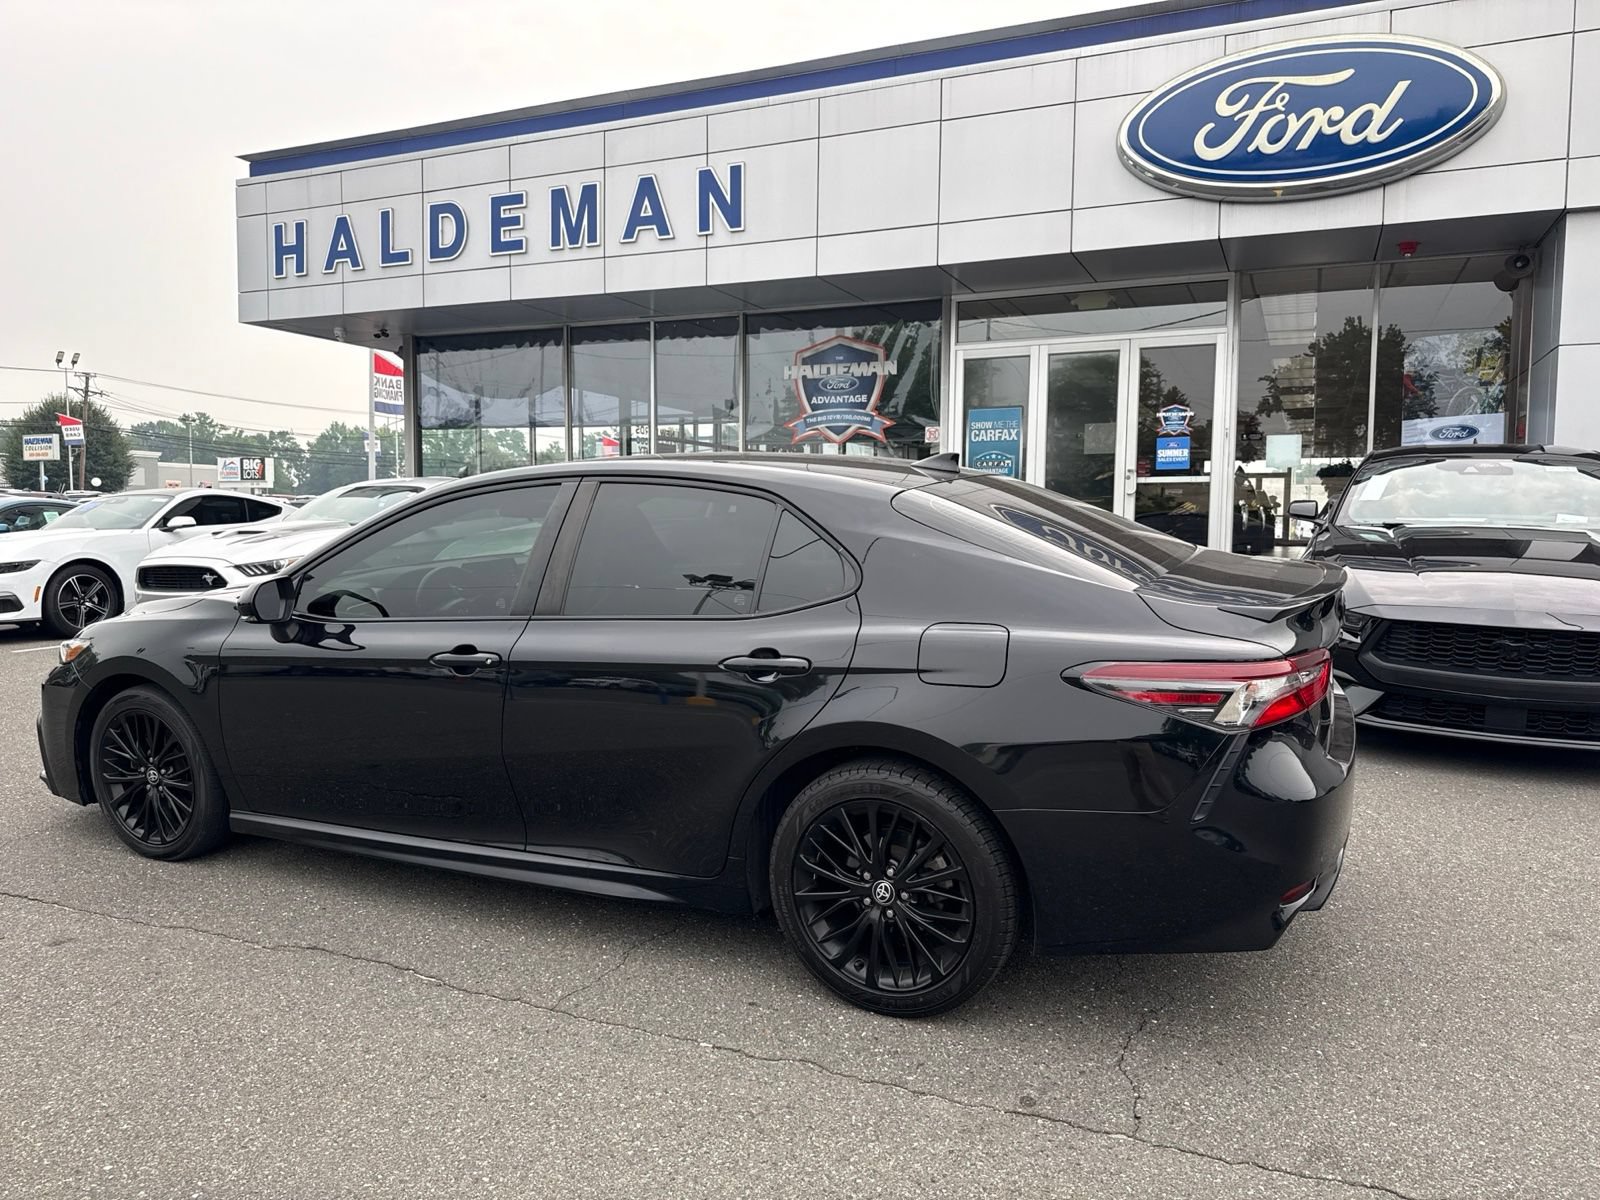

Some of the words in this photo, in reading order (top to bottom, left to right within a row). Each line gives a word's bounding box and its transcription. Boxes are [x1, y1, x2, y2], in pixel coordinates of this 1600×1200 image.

[1193, 68, 1412, 161] Ford
[273, 161, 746, 280] HALDEMAN
[783, 360, 898, 380] HALDEMAN
[826, 378, 850, 390] Ford
[811, 394, 868, 404] ADVANTAGE
[971, 421, 992, 429] SHOW
[993, 421, 1005, 429] ME
[1006, 420, 1018, 428] THE
[971, 429, 1018, 441] CARFAX
[1439, 427, 1469, 438] Ford
[1157, 449, 1189, 457] SUMMER
[242, 459, 261, 470] BIG
